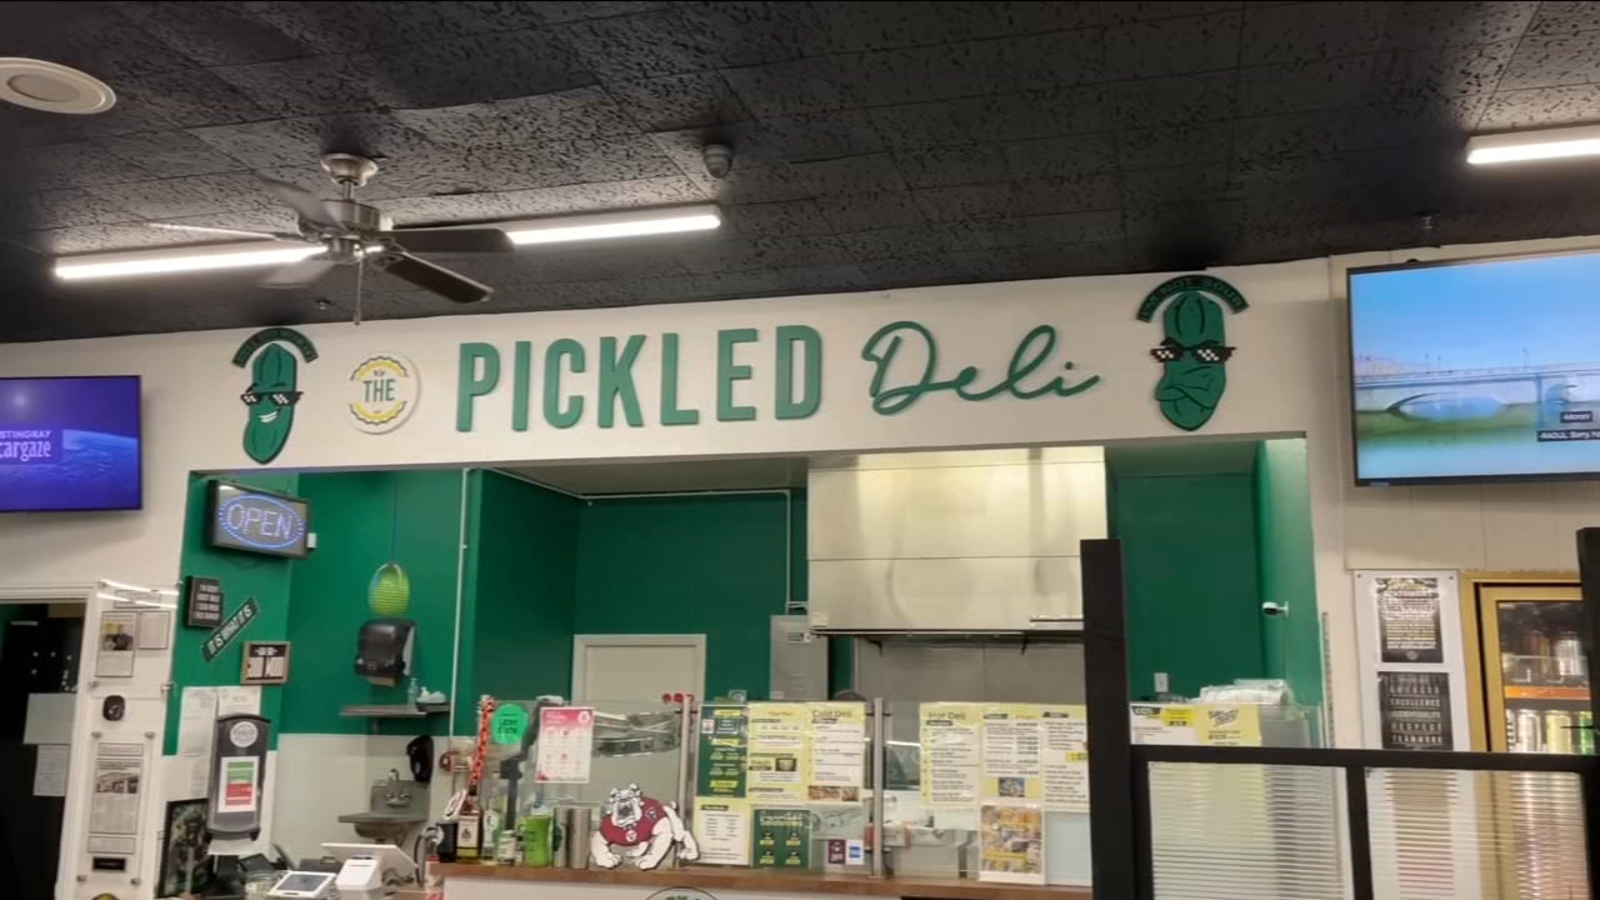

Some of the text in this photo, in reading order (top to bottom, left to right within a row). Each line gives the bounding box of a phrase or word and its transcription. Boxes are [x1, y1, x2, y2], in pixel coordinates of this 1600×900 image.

[362, 320, 1100, 432] THE PICKLED Deli
[0, 430, 52, 439] STINGRAY
[227, 503, 292, 540] OPEN
[947, 711, 967, 720] Deli
